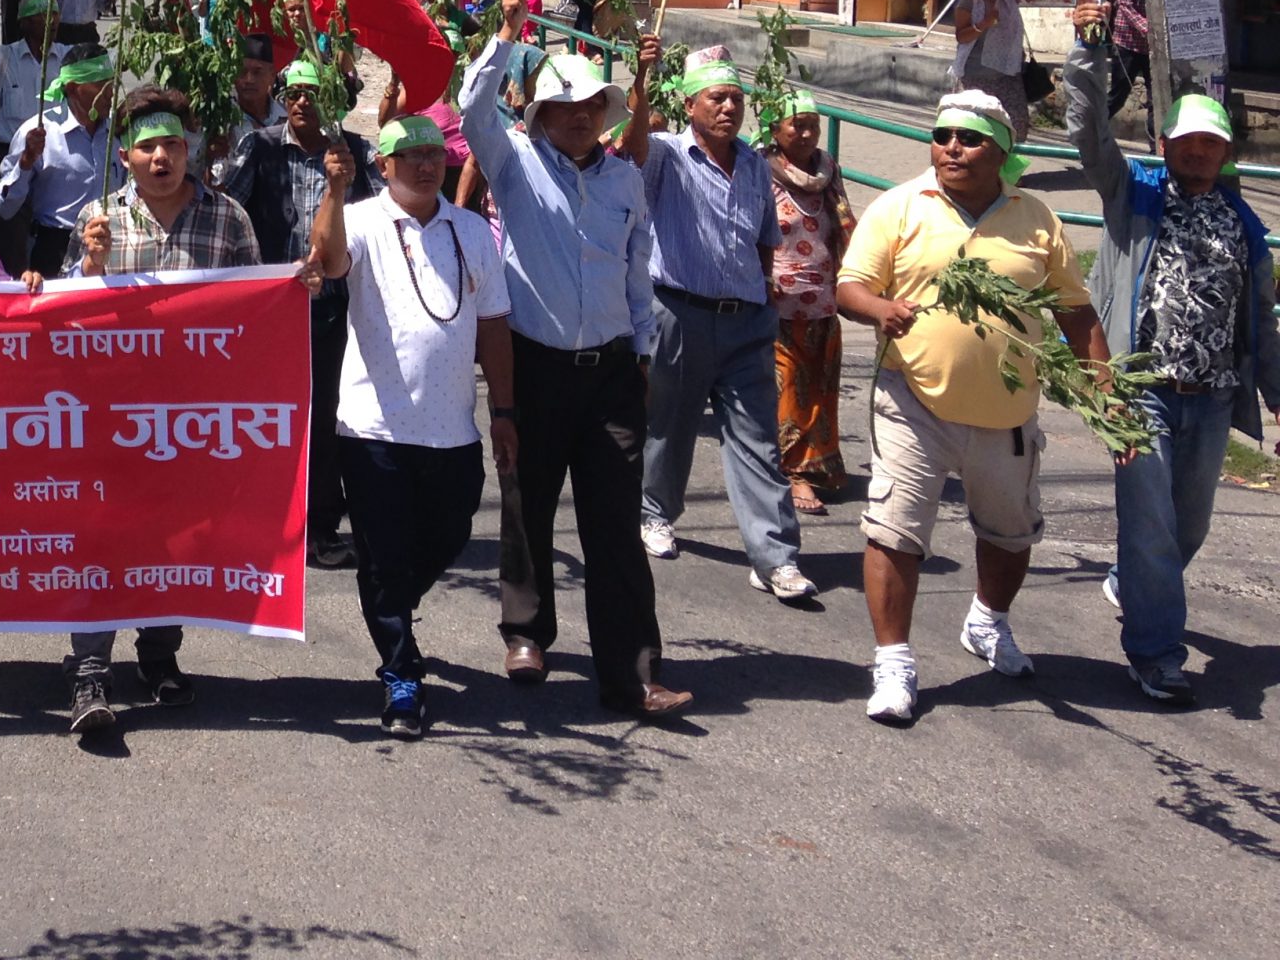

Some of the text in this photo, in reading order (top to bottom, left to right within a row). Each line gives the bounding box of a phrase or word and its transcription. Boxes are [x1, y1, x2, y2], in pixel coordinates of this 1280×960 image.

[50, 322, 165, 359] घोषणा
[110, 403, 298, 461] जुलुस
[13, 475, 81, 502] असोज
[93, 480, 105, 502] १
[124, 565, 215, 593] तमुवान
[223, 563, 285, 598] प्रदेश
